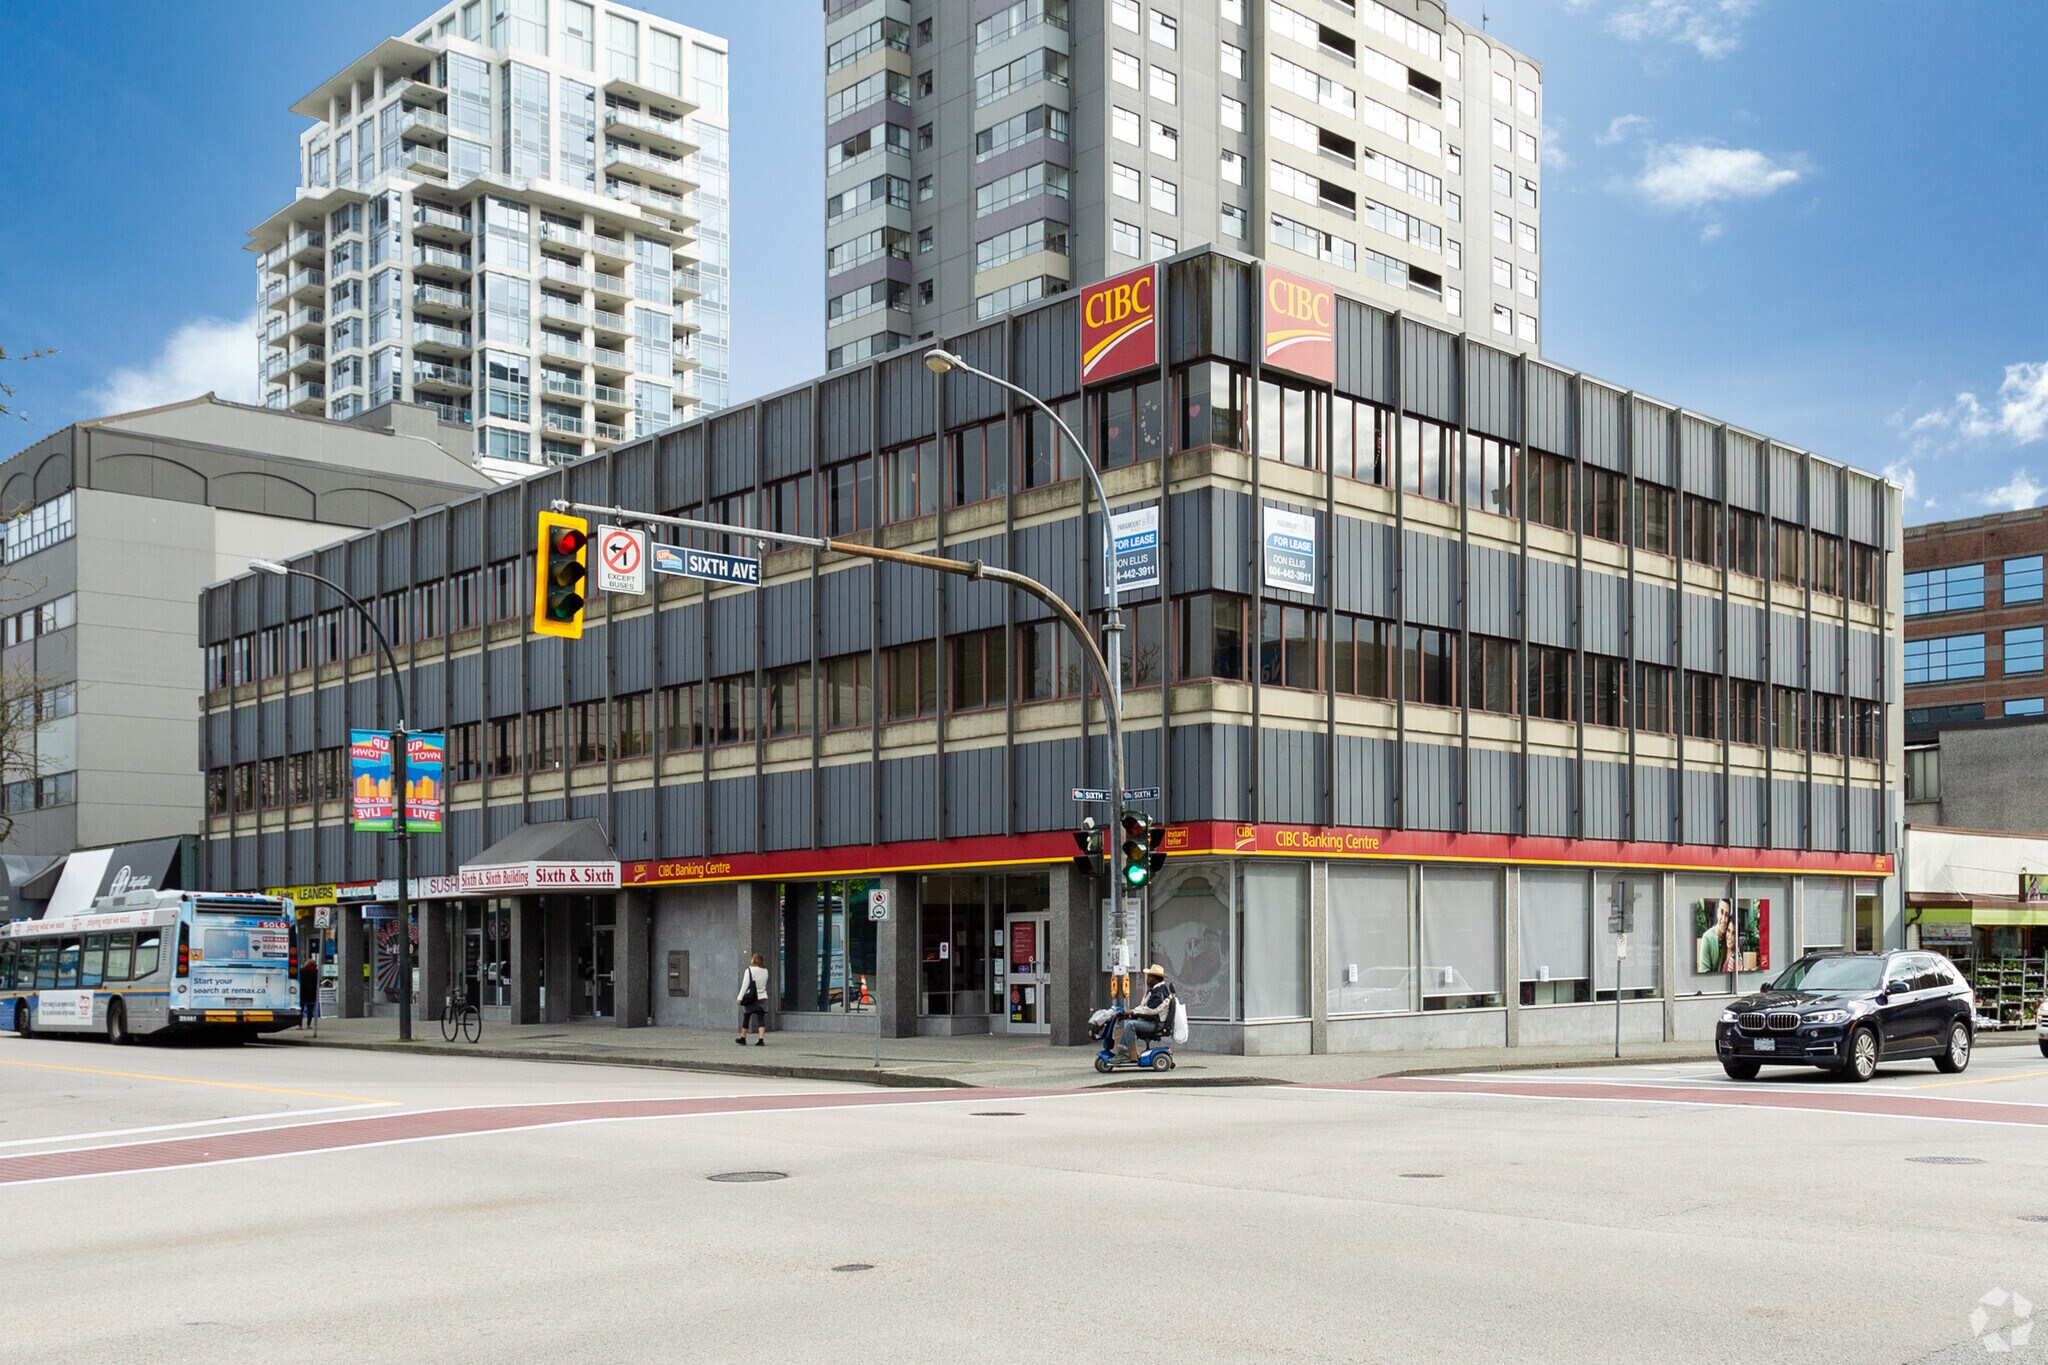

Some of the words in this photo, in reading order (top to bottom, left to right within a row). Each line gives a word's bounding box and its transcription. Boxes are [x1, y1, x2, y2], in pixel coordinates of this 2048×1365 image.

[1085, 276, 1151, 328] CIBC
[1268, 278, 1330, 328] CIBC
[1130, 533, 1155, 547] LEASE
[1273, 535, 1289, 548] FOR
[1289, 539, 1312, 552] LEASE
[1129, 554, 1149, 566] ELLIS
[1273, 554, 1288, 565] DON
[1288, 557, 1306, 569] ELLIS
[689, 555, 728, 576] SIXTH
[731, 561, 758, 581] AVE
[1114, 565, 1155, 581] 4-442-3911
[1268, 565, 1311, 583] 604-442-3911
[607, 572, 636, 582] EXCEPT
[609, 580, 634, 590] BUSES
[407, 741, 423, 752] UP
[414, 752, 441, 760] TOWN
[1085, 791, 1103, 799] SIXTH
[1133, 790, 1151, 799] SIXTH
[412, 808, 436, 821] LIVE
[1236, 825, 1255, 838] CIBC
[1167, 837, 1182, 846] teller
[1275, 830, 1301, 847] CIBC
[1302, 832, 1343, 852] Banking
[1345, 833, 1379, 850] Centre
[536, 868, 565, 883] Sixth
[569, 868, 580, 883] &
[584, 868, 614, 883] Sixth
[658, 863, 674, 877] CIBC
[675, 862, 704, 878] Banking
[705, 861, 731, 874] Centre
[461, 872, 477, 887] Sixth
[478, 872, 484, 885] &
[486, 870, 501, 885] Sixth
[503, 868, 529, 887] Building
[430, 876, 459, 894] SUSHI
[297, 886, 333, 900] LEANERS
[193, 977, 213, 985] Start
[215, 978, 233, 986] your
